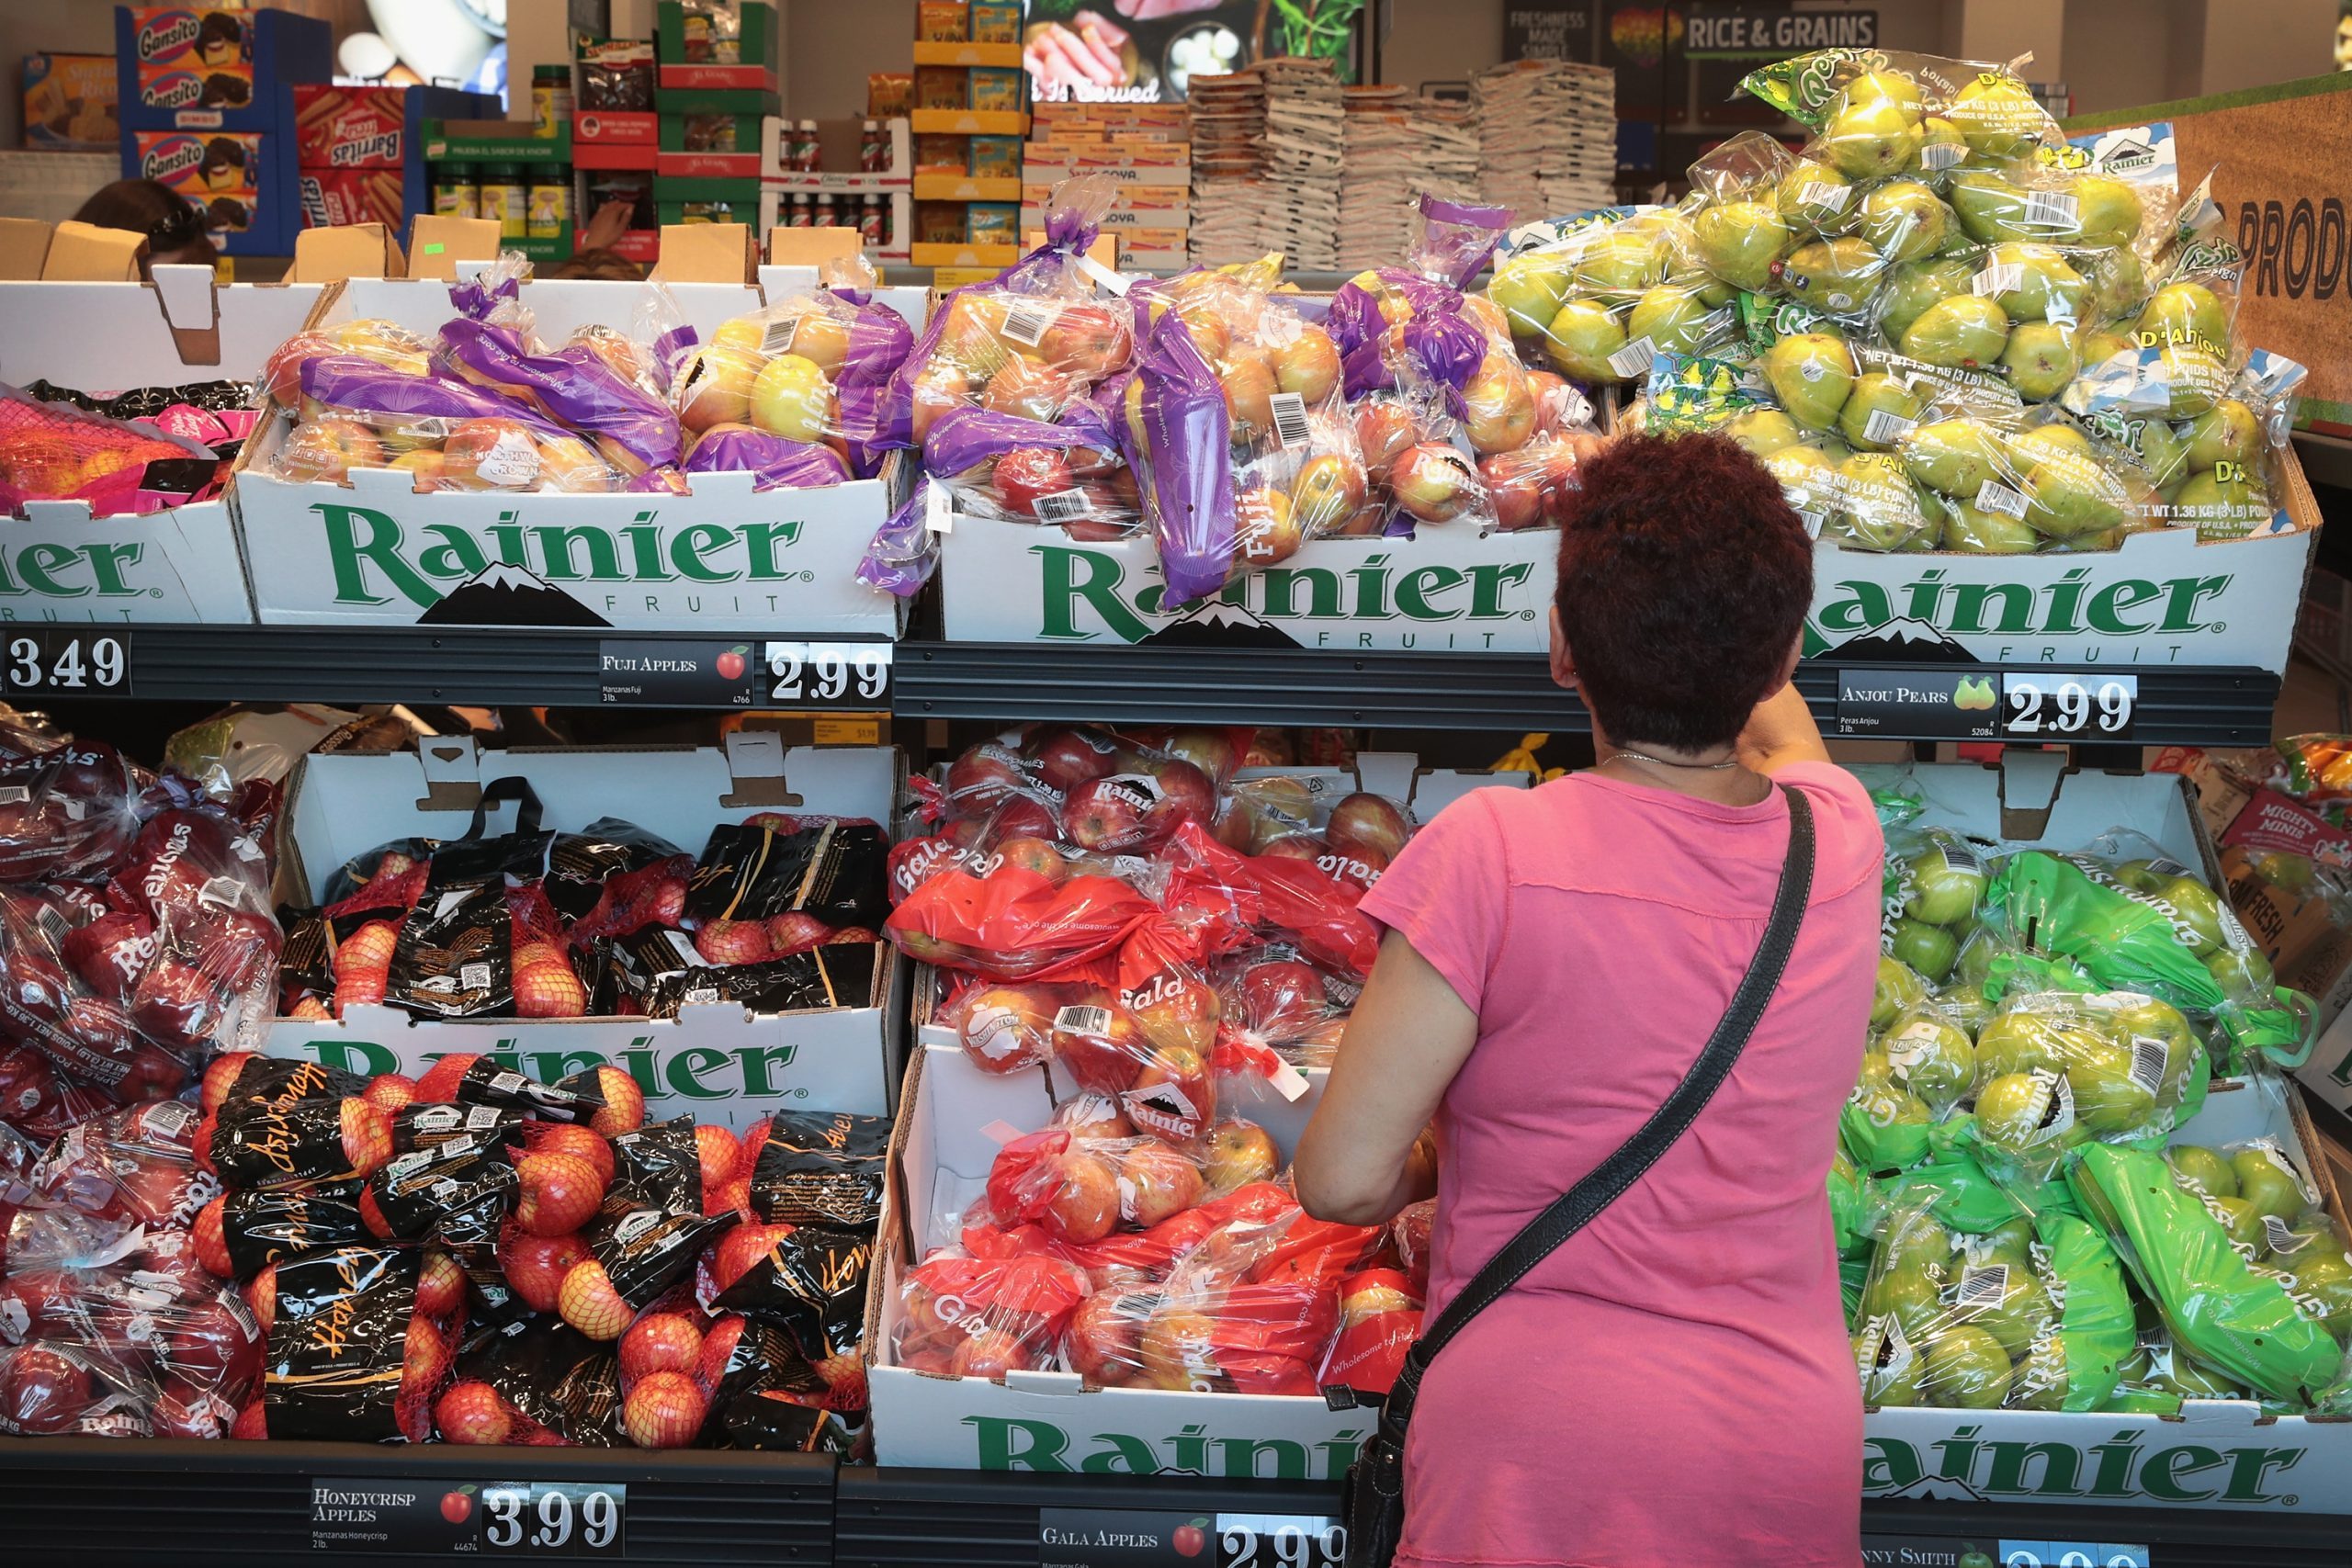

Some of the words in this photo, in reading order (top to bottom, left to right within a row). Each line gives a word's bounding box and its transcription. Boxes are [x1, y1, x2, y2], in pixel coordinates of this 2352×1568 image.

[140, 19, 200, 61] Gansito
[1689, 17, 1745, 47] RICE
[1750, 18, 1775, 46] &
[1776, 16, 1873, 47] GRAINS
[143, 142, 205, 180] Gansito
[332, 130, 399, 165] Barritas
[2102, 154, 2155, 175] Rainier
[2238, 196, 2352, 300] PROD
[1865, 349, 1887, 363] NET
[925, 414, 970, 447] Wholesome
[1238, 487, 1274, 558] Fuji
[2153, 505, 2169, 517] WT
[2172, 505, 2196, 518] 1.36
[2199, 505, 2215, 518] KG
[2166, 521, 2200, 530] PRODUCE
[309, 502, 805, 610] Rainier
[605, 594, 779, 613] FRUIT
[1318, 632, 1496, 649] FRUIT
[1998, 646, 2183, 662] FRUIT
[9, 637, 126, 689] 3.49
[602, 655, 637, 672] FUJI
[639, 656, 698, 673] APPLES
[770, 649, 888, 701] 2.99
[603, 686, 630, 694] Manzanas
[732, 695, 751, 705] 4766
[1841, 686, 1894, 705] ANJOU
[1896, 686, 1949, 705] PEARS
[2007, 681, 2132, 733] 2.99
[1840, 716, 1859, 725] Peras
[1860, 716, 1880, 728] Anjou
[1972, 728, 1995, 737] 52084
[2259, 818, 2306, 840] MINIS
[2260, 804, 2318, 835] MIGHTY
[896, 837, 955, 894] Gala
[2249, 889, 2286, 945] FRESH
[1120, 974, 1185, 1012] Gala
[302, 1036, 799, 1100] Rinier
[414, 1116, 458, 1129] Rainier
[390, 1151, 434, 1179] Rainier
[617, 1211, 662, 1244] Rainier
[1331, 1341, 1384, 1375] Wholesome
[960, 1415, 1366, 1480] Raini
[1862, 1424, 2308, 1504] ainier
[313, 1488, 416, 1506] HONEYCRISP
[312, 1506, 377, 1523] APPLES
[486, 1489, 618, 1549] 3.99
[312, 1530, 347, 1540] Manzanas
[348, 1531, 388, 1541] Honeycrisp
[454, 1543, 478, 1551] 44674
[1042, 1527, 1090, 1547] GALA
[1094, 1529, 1159, 1549] APPLES
[1862, 1550, 1894, 1565] NNY
[1900, 1547, 1956, 1567] SMITH
